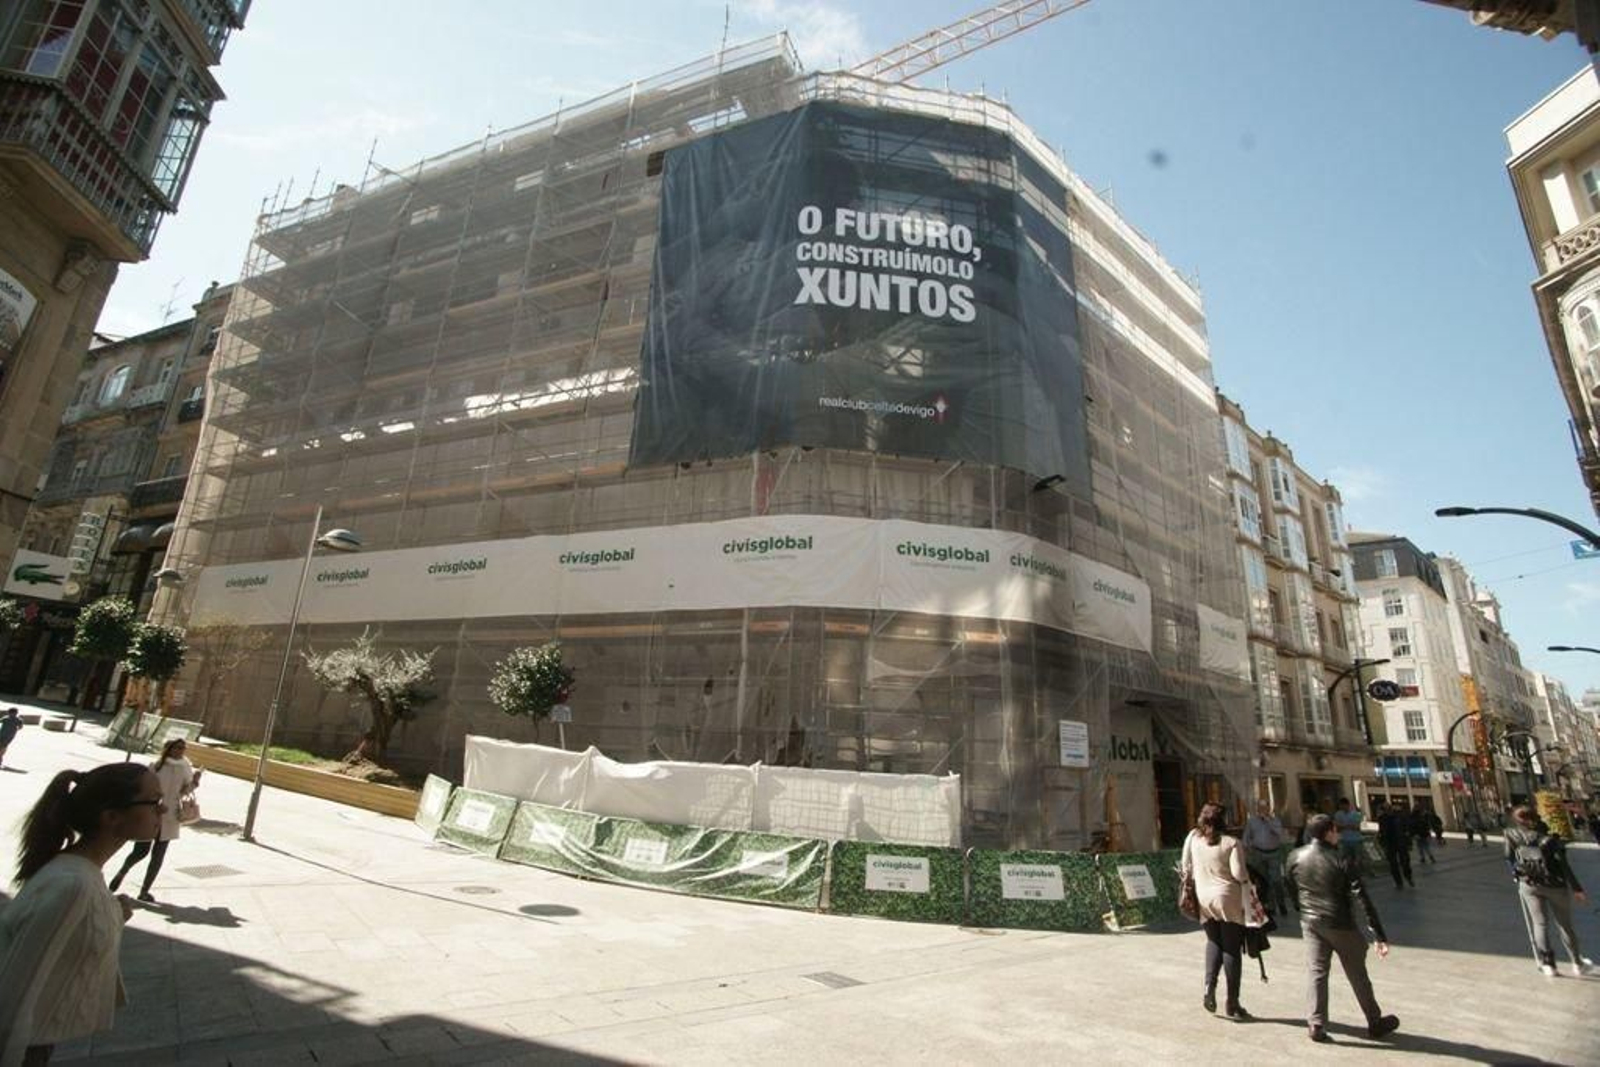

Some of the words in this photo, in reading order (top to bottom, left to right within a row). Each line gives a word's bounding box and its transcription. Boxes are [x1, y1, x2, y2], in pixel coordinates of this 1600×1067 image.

[797, 205, 823, 236] O
[834, 206, 983, 263] FUTURO,
[795, 241, 975, 281] CONSTRUÍMOLO
[794, 266, 977, 323] XUNTOS
[722, 535, 814, 555] civisglobal
[895, 541, 991, 564] civisglobal
[427, 557, 488, 575] civisglobal
[558, 547, 635, 566] civisglobal
[316, 567, 370, 583] civisglobal
